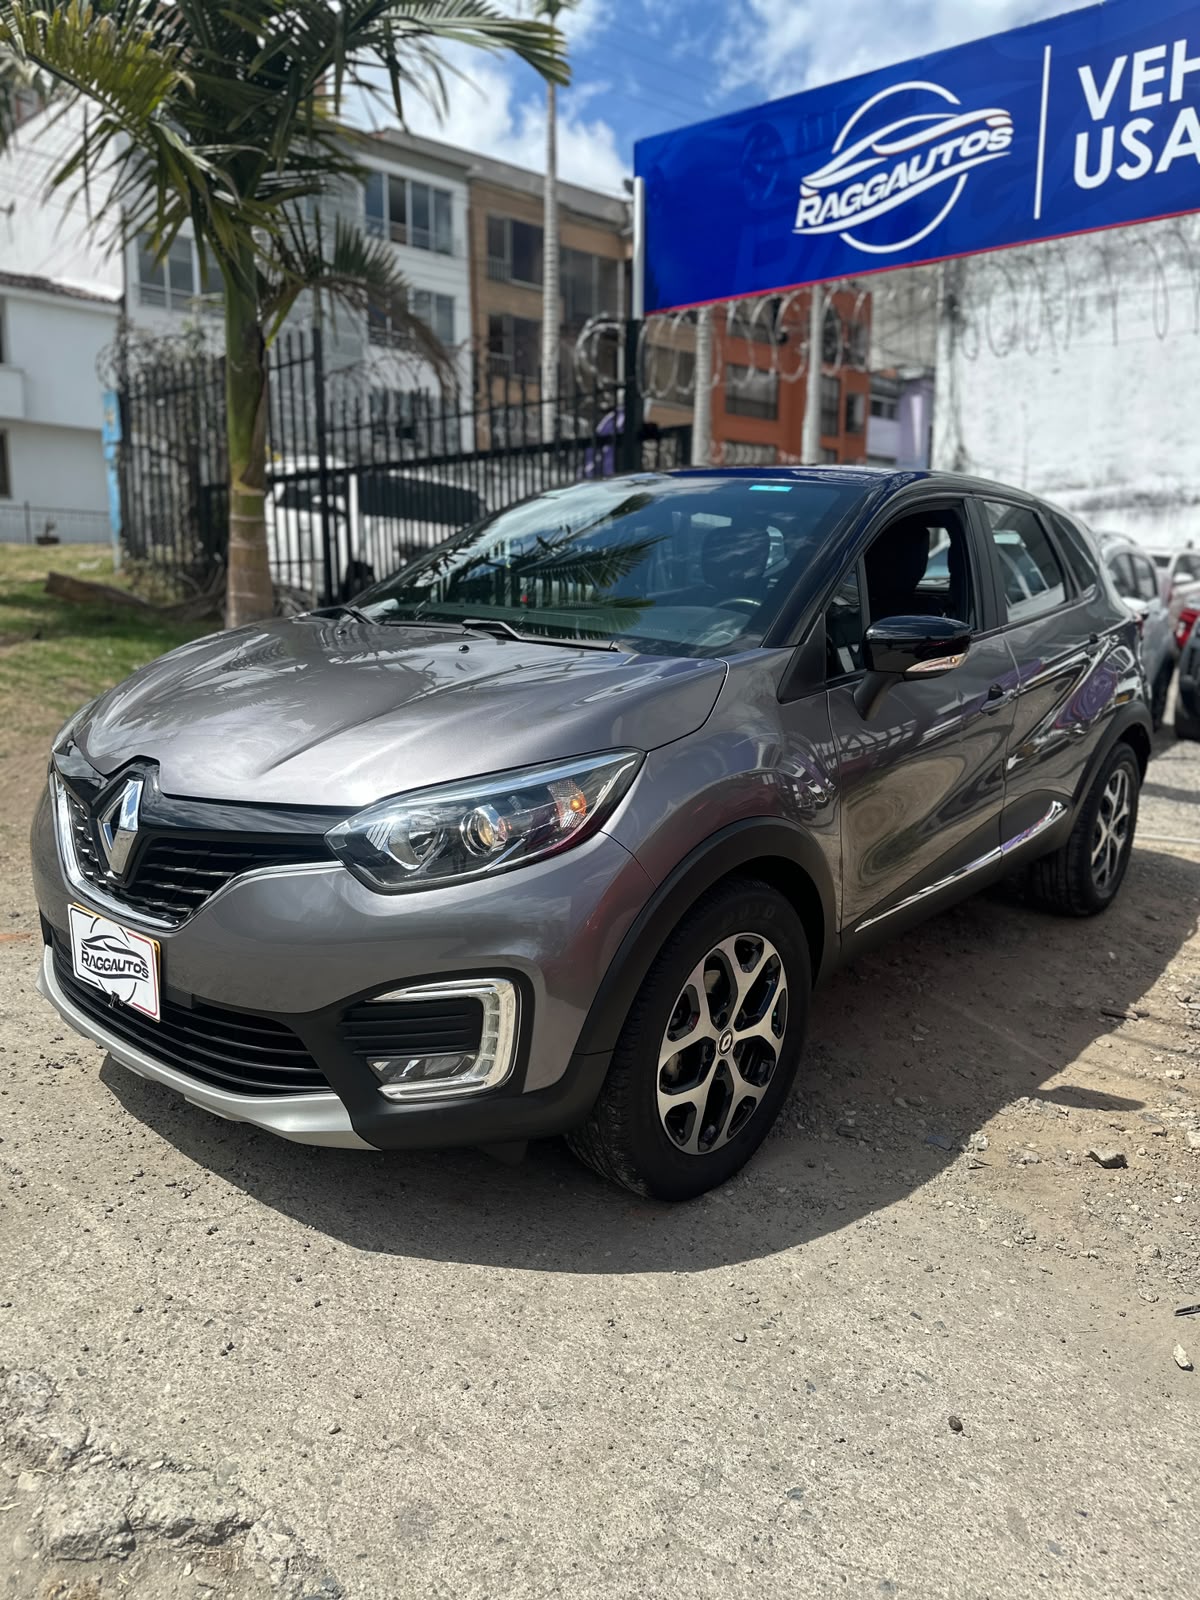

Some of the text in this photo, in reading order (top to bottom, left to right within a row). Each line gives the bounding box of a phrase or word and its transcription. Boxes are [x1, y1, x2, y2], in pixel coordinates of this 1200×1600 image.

[795, 126, 1014, 228] RAGGAUTOS
[1074, 106, 1200, 189] USA
[81, 950, 149, 979] RAGGAUTOS
